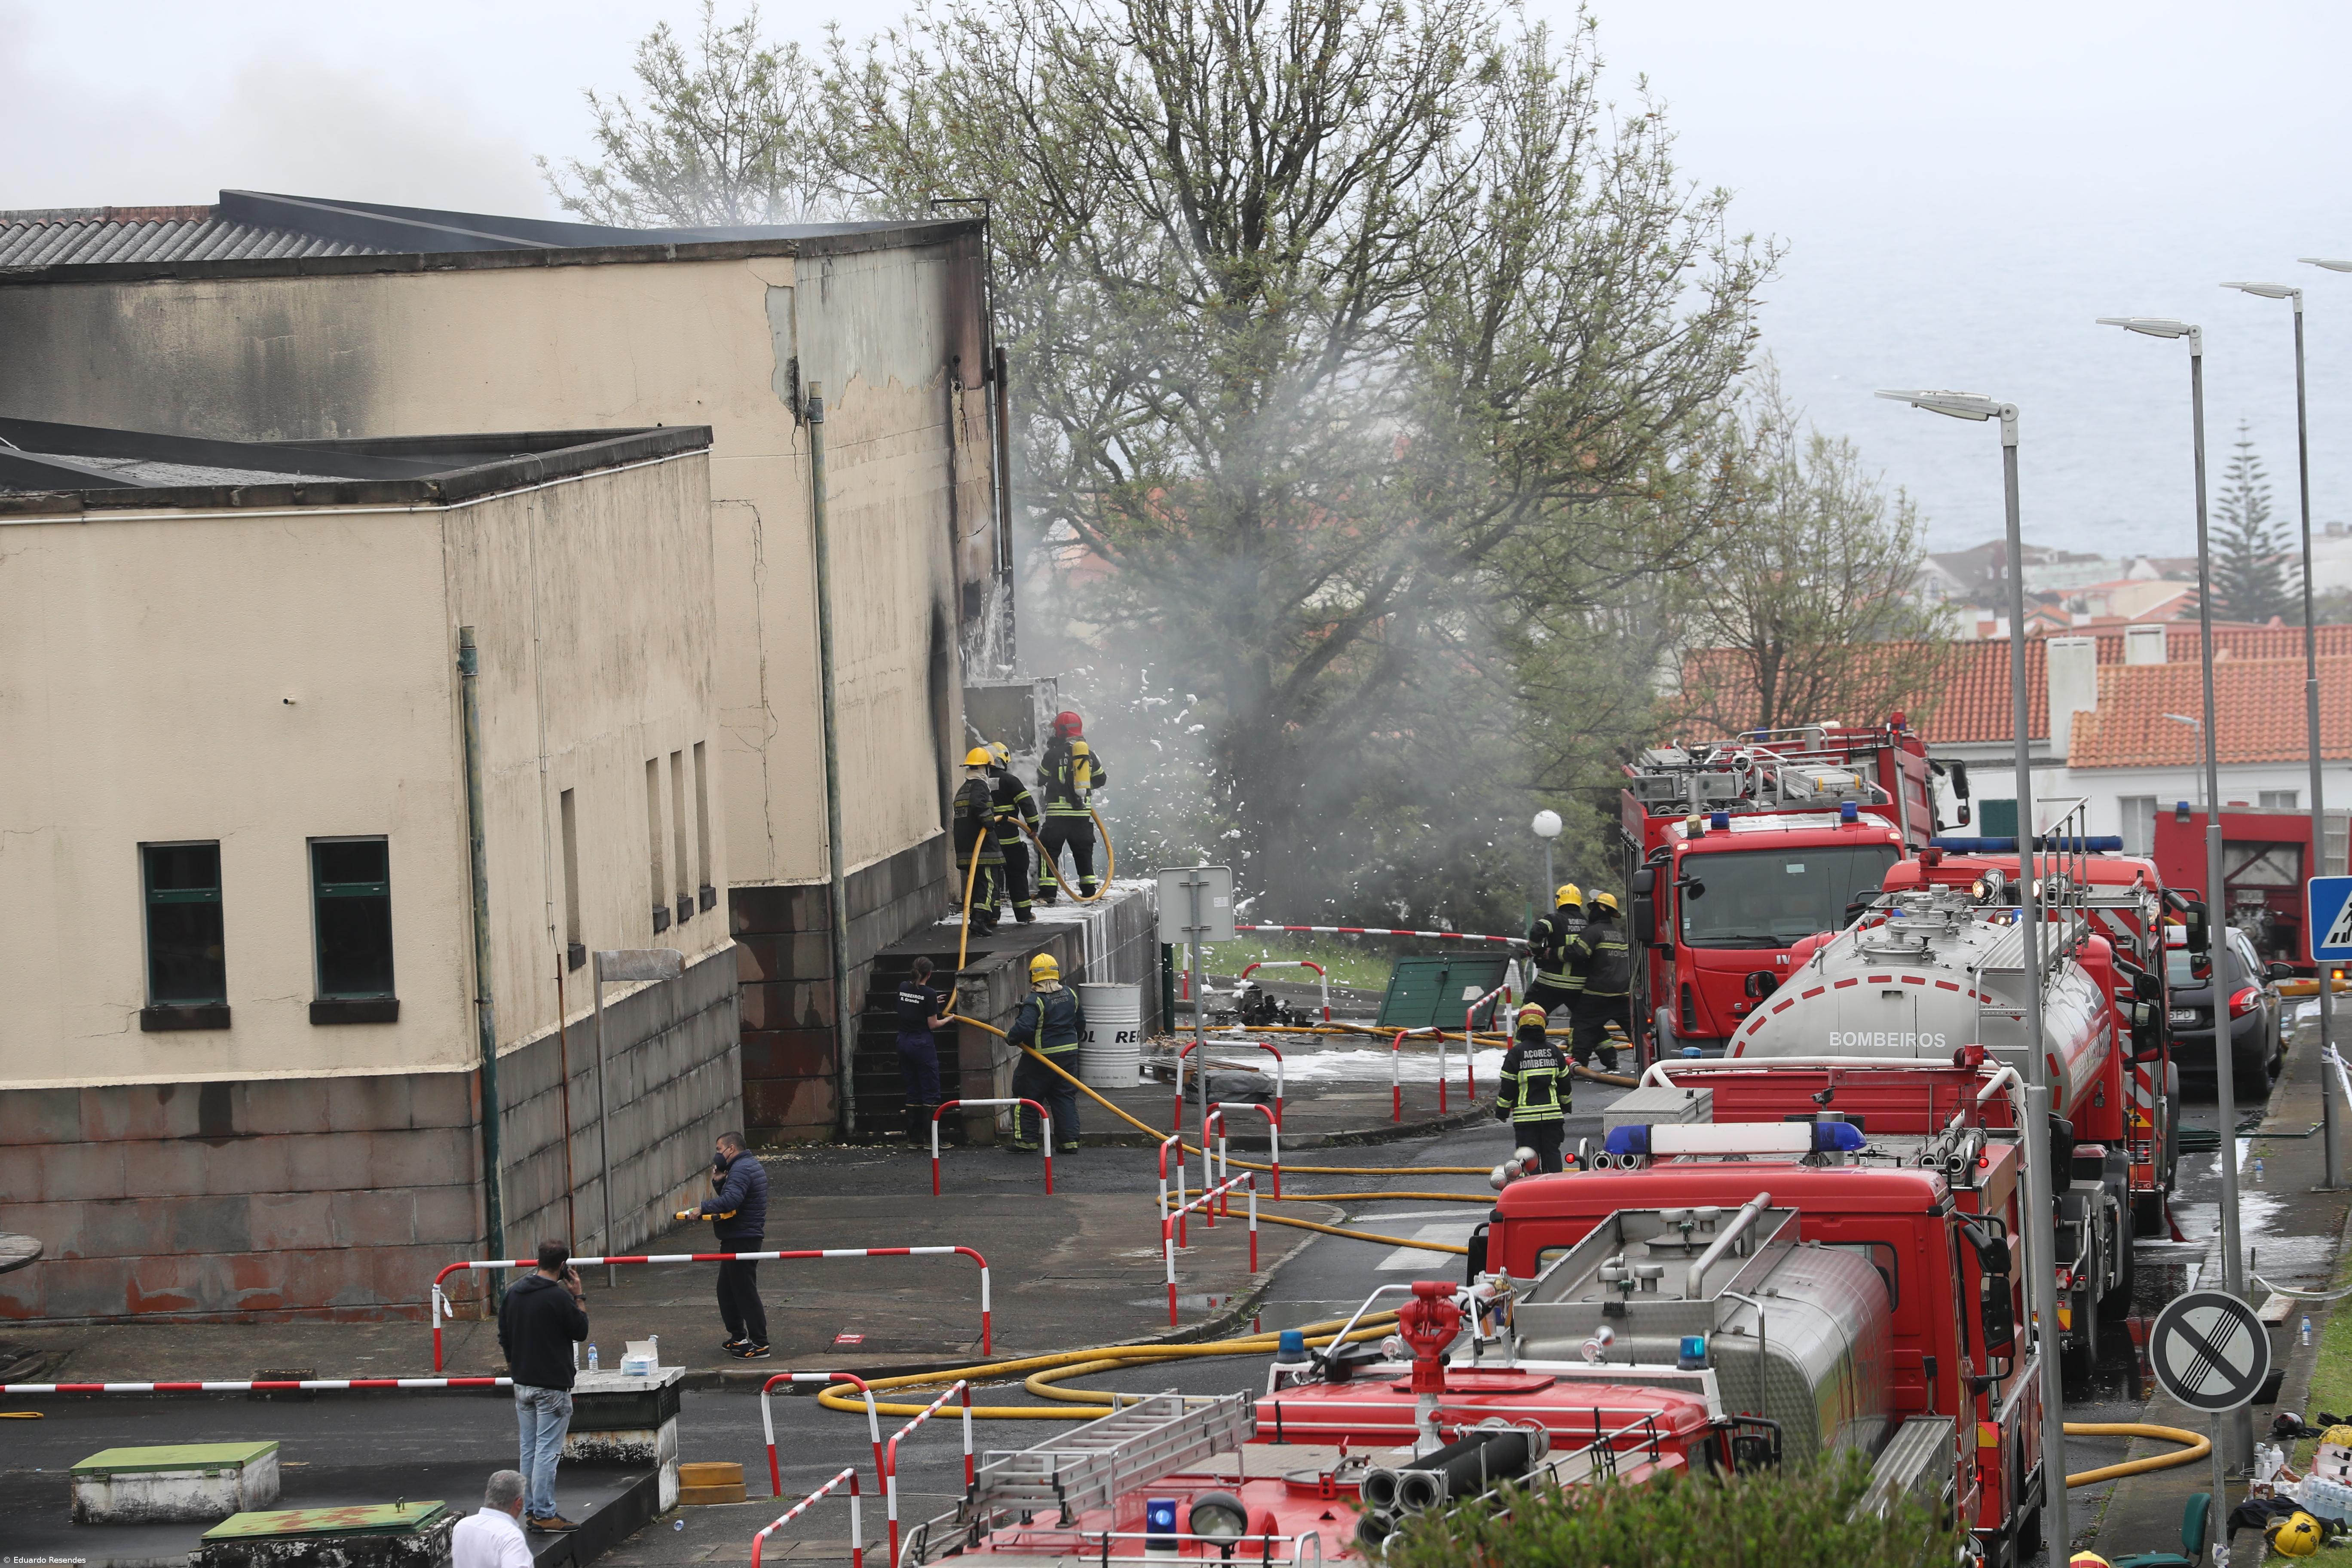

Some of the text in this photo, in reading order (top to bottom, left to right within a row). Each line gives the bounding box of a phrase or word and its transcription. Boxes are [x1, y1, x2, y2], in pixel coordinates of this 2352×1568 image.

[899, 992, 925, 1000] BOMBEIROS
[1829, 1032, 1946, 1047] BOMBEIROS
[1524, 1049, 1552, 1059] AÇORES
